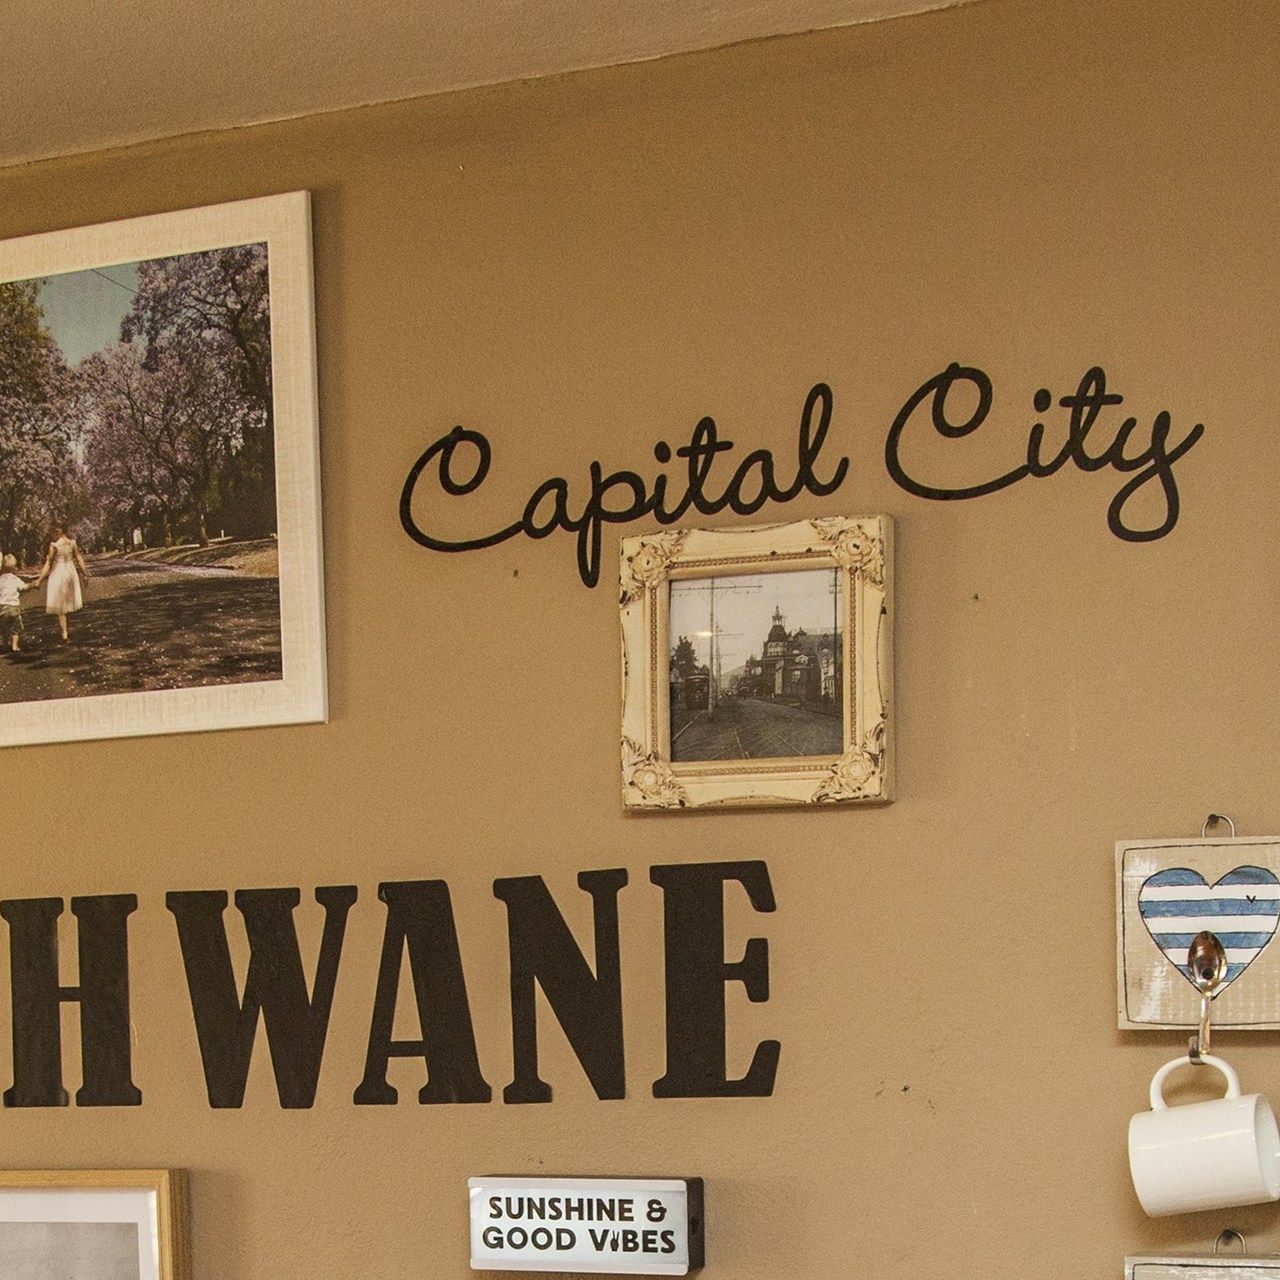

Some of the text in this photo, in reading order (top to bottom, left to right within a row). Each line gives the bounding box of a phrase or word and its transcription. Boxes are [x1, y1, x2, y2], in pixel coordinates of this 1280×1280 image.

[398, 362, 1205, 589] Capital City
[488, 1196, 667, 1223] SUNSHINE &
[482, 1226, 577, 1250] GOOD
